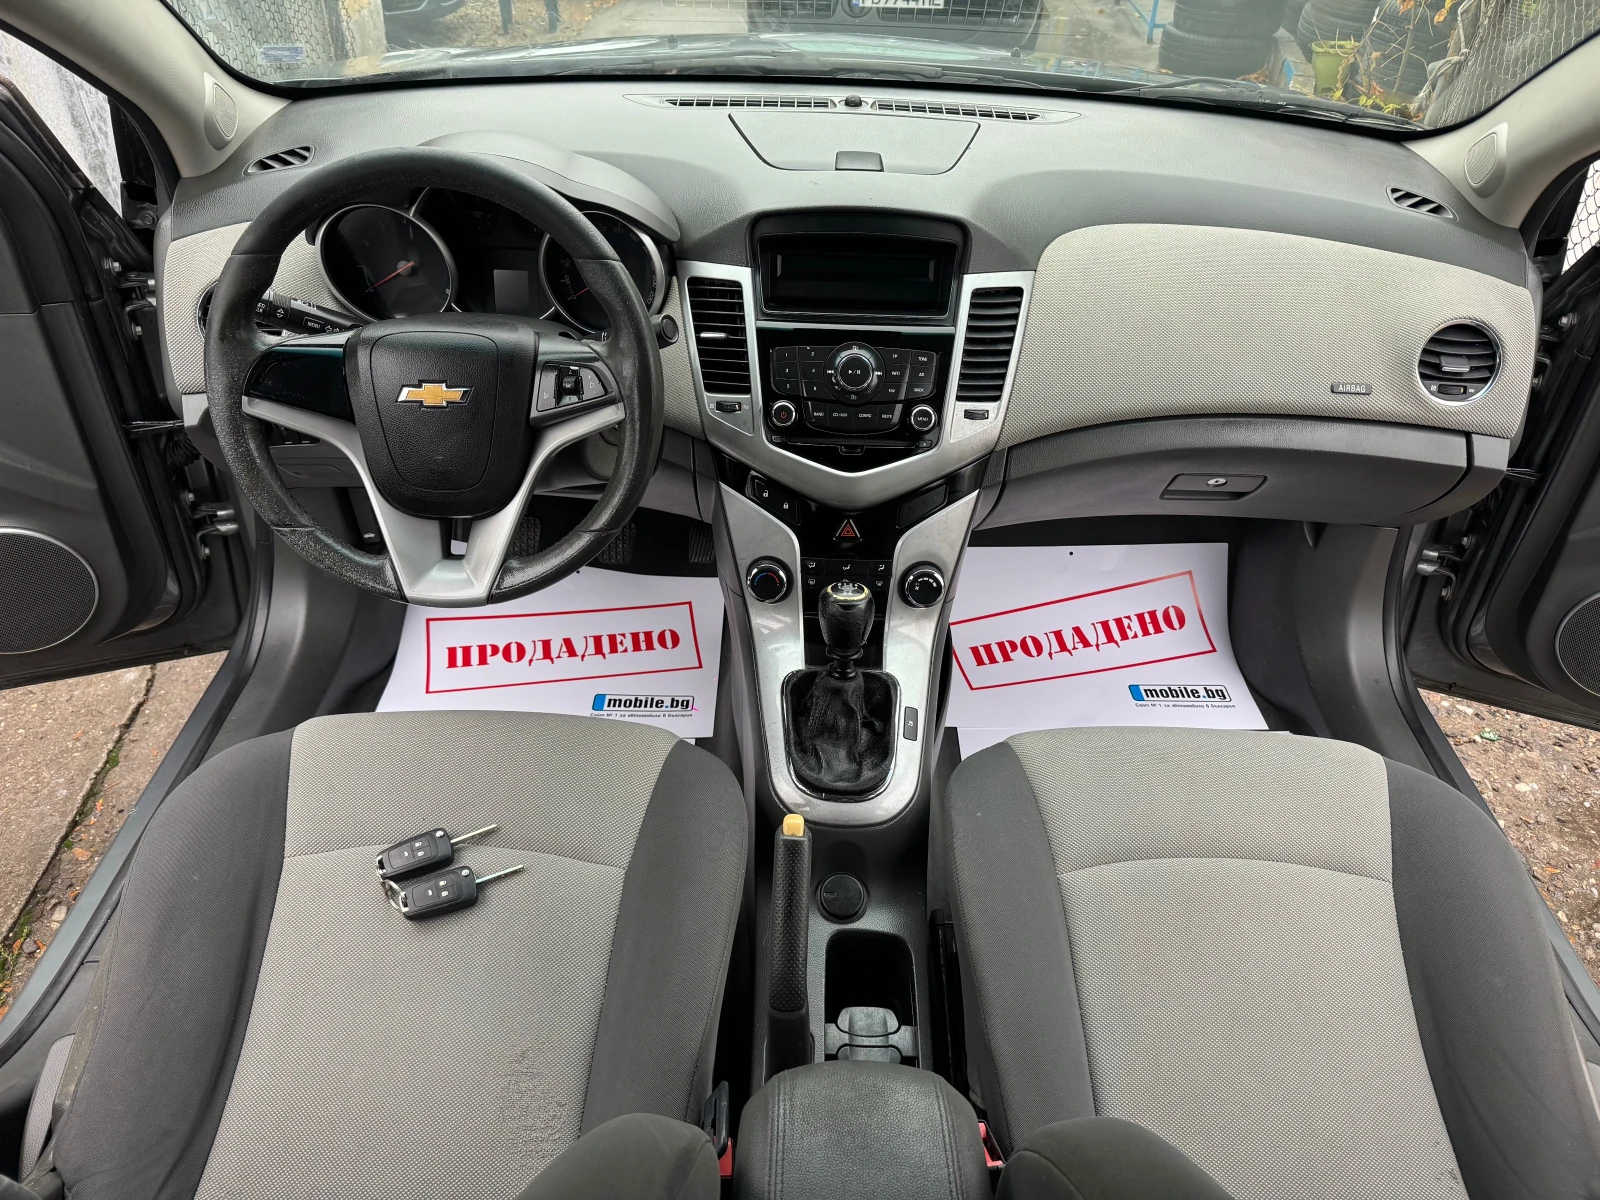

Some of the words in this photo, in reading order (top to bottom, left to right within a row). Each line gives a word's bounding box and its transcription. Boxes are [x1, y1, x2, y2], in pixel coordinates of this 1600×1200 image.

[1337, 384, 1367, 393] AIRBAG
[969, 605, 1186, 667] ПРОДАДЕНО
[445, 628, 680, 668] ПРОДАДЕНО
[1143, 686, 1227, 700] mobile.bg
[607, 697, 690, 710] mobile.bg
